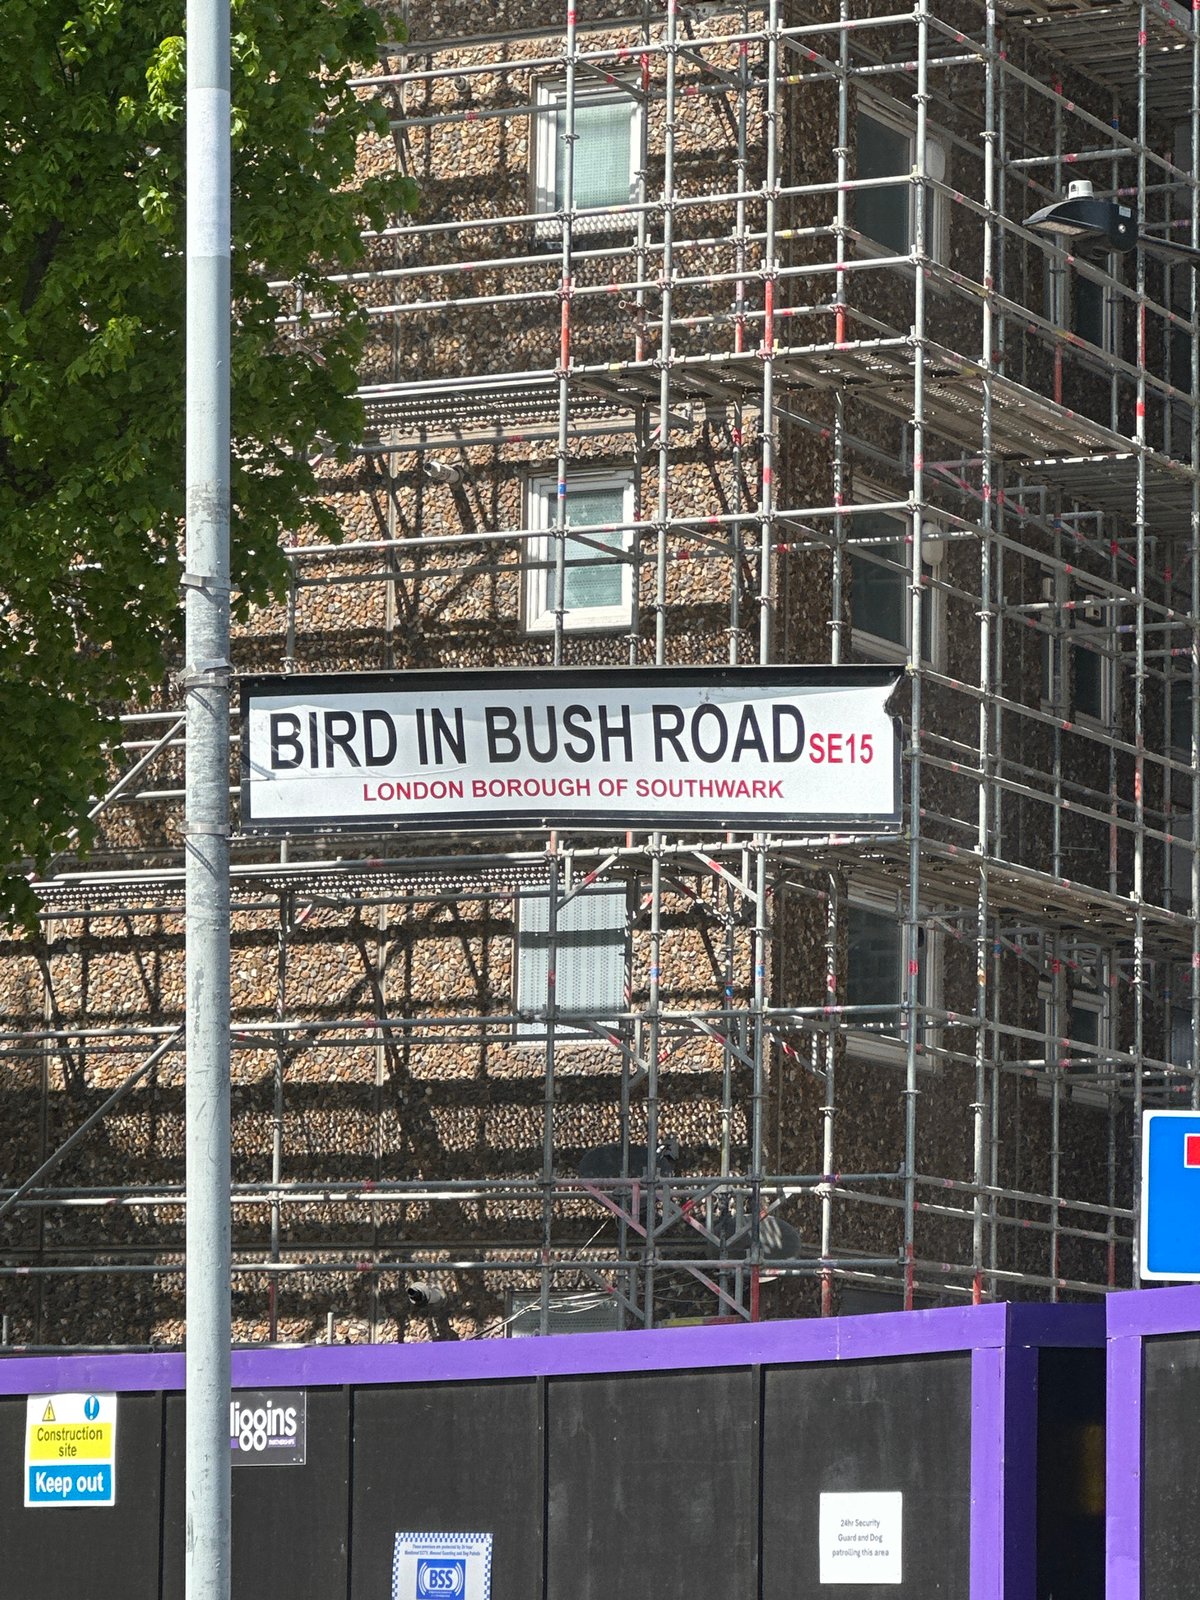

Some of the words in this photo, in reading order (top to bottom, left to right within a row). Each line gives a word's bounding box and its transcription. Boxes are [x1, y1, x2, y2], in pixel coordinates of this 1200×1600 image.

[270, 709, 397, 770] BIRD
[415, 707, 467, 765] IN
[484, 704, 633, 763] BUSH
[652, 703, 806, 763] ROAD
[809, 732, 874, 764] SE15
[363, 780, 464, 801] LONDON
[472, 778, 591, 799] BOROUGH
[598, 778, 628, 797] OF
[636, 778, 785, 799] SOUTHWARK
[37, 1426, 103, 1442] Construction
[58, 1442, 77, 1457] site
[35, 1471, 73, 1498] Keep
[76, 1471, 104, 1493] out
[840, 1519, 854, 1528] 24hr
[855, 1519, 880, 1529] Security
[838, 1534, 857, 1542] Guard
[858, 1534, 869, 1542] and
[870, 1534, 883, 1543] Dog
[832, 1549, 861, 1559] patrolling
[862, 1548, 873, 1556] this
[429, 1569, 453, 1589] BSS
